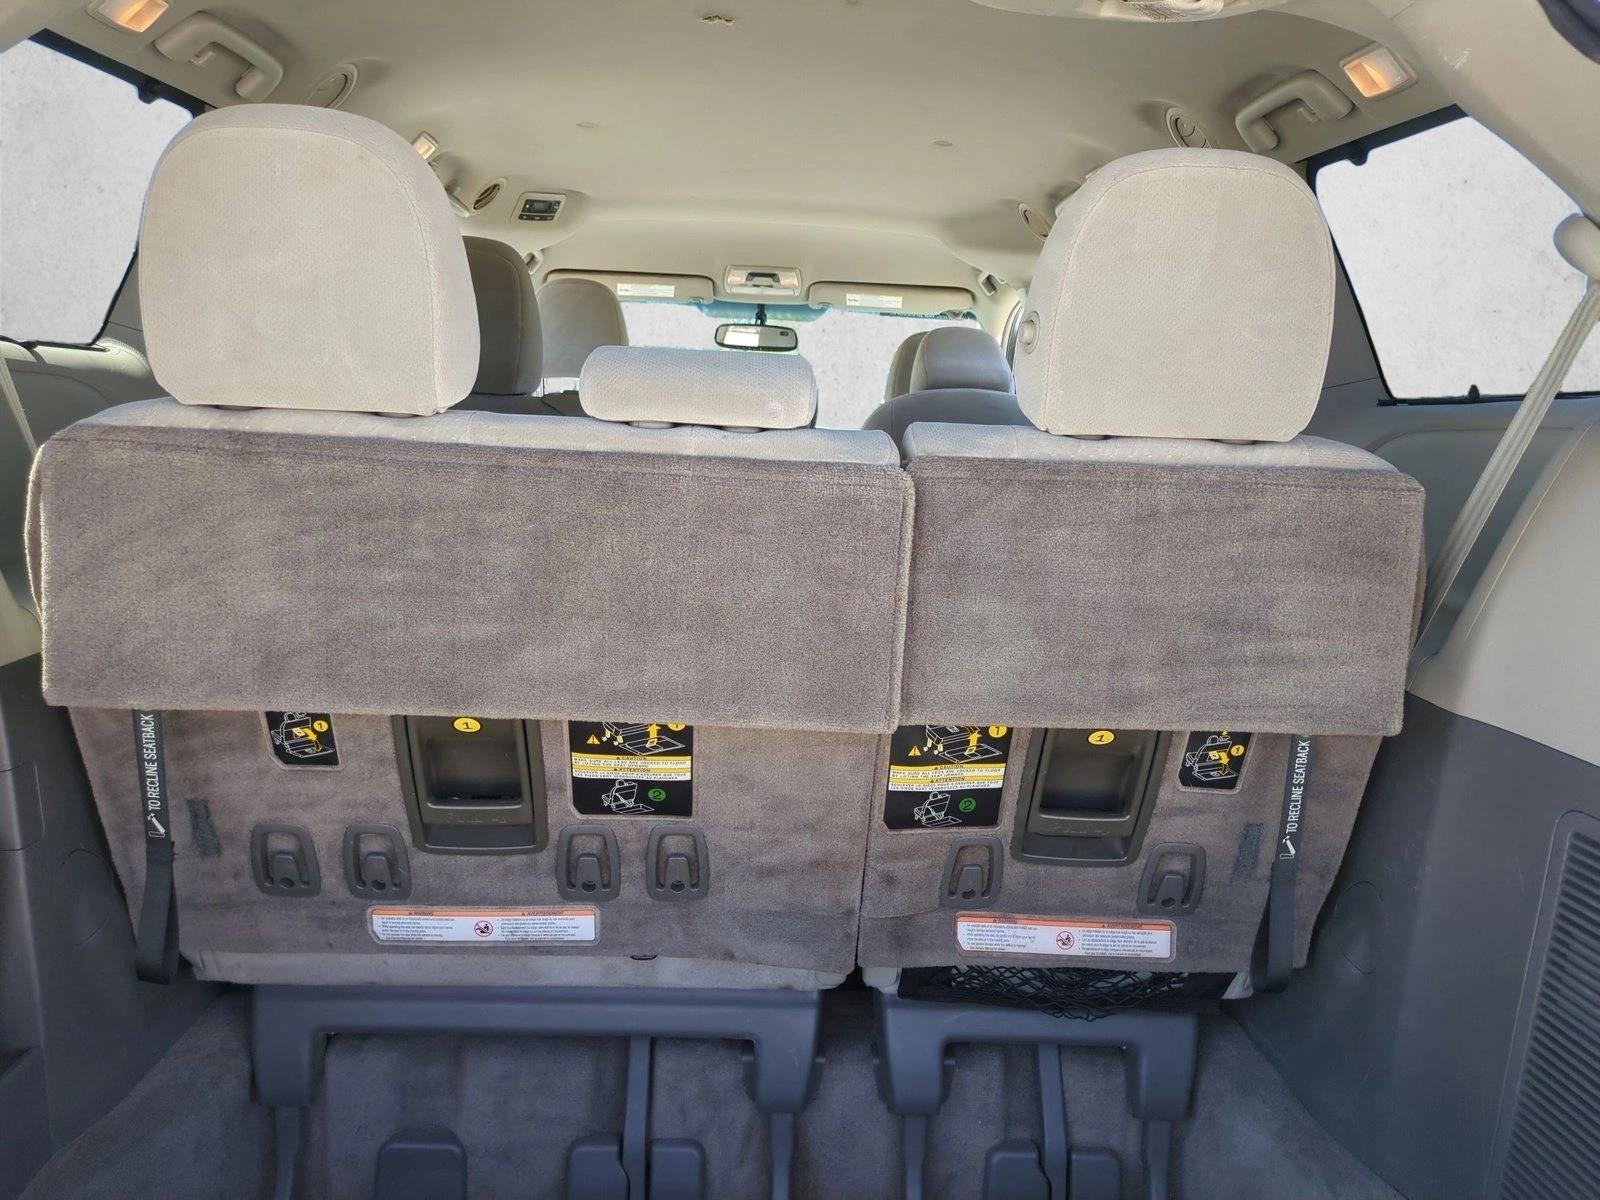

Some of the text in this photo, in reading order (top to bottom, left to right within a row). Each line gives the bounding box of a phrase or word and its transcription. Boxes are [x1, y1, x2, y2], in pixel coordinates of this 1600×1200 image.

[140, 713, 161, 811] TO RECLINE SEATBACK
[1286, 739, 1311, 834] TO RECLINE SEATBACK
